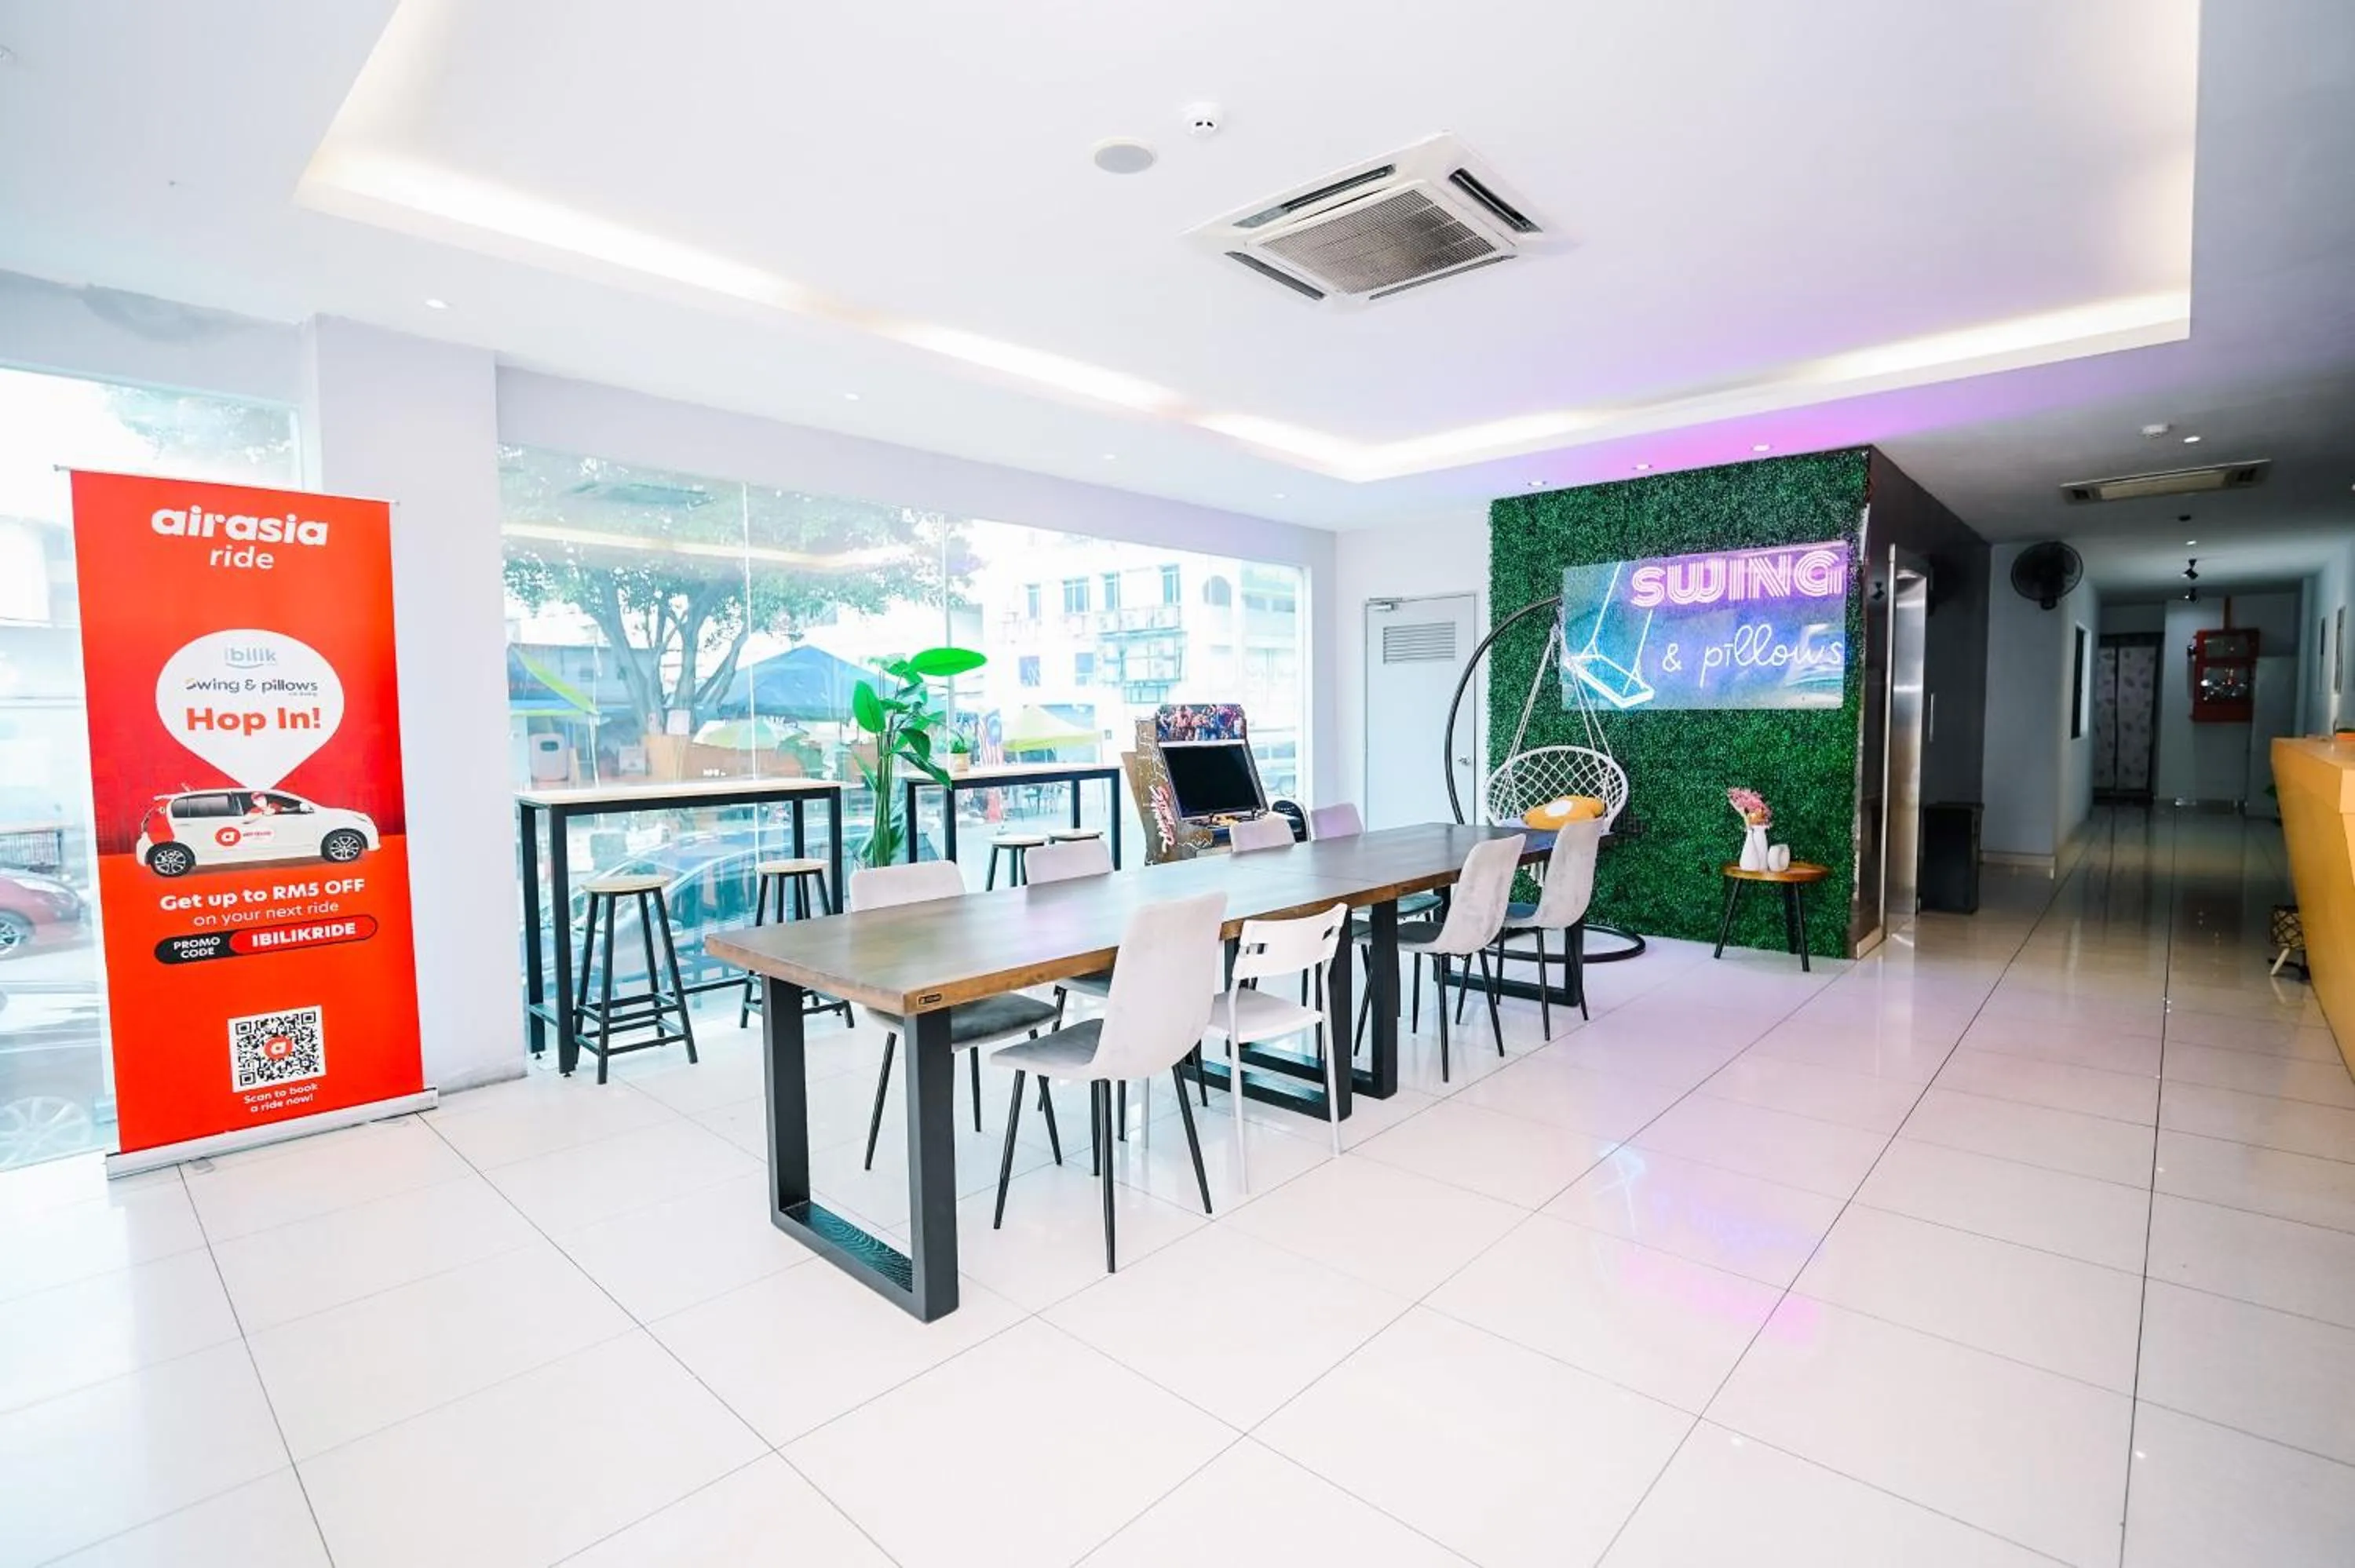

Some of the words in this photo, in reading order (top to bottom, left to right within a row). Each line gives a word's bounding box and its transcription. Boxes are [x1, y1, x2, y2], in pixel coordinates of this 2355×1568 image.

[151, 505, 328, 545] airasia
[210, 545, 275, 570] ride
[1631, 551, 1842, 607] SWING
[1663, 644, 1681, 672] &
[1700, 624, 1842, 688] pillows
[261, 679, 318, 695] pillows
[186, 707, 266, 736] Hop
[277, 707, 321, 729] In!
[160, 895, 203, 910] Get
[208, 892, 237, 907] up
[243, 888, 267, 903] to
[272, 882, 319, 900] RM5
[324, 878, 365, 894] OFF
[193, 913, 216, 926] on
[221, 910, 260, 926] your
[266, 906, 302, 918] next
[307, 901, 339, 914] ride
[173, 936, 221, 950] PROMO
[251, 922, 356, 947] IBILIKRIDE
[180, 947, 215, 958] CODE
[244, 1092, 272, 1104] Scan
[274, 1089, 287, 1098] to
[289, 1083, 318, 1095] book
[261, 1099, 283, 1111] ride
[286, 1093, 313, 1105] now!
